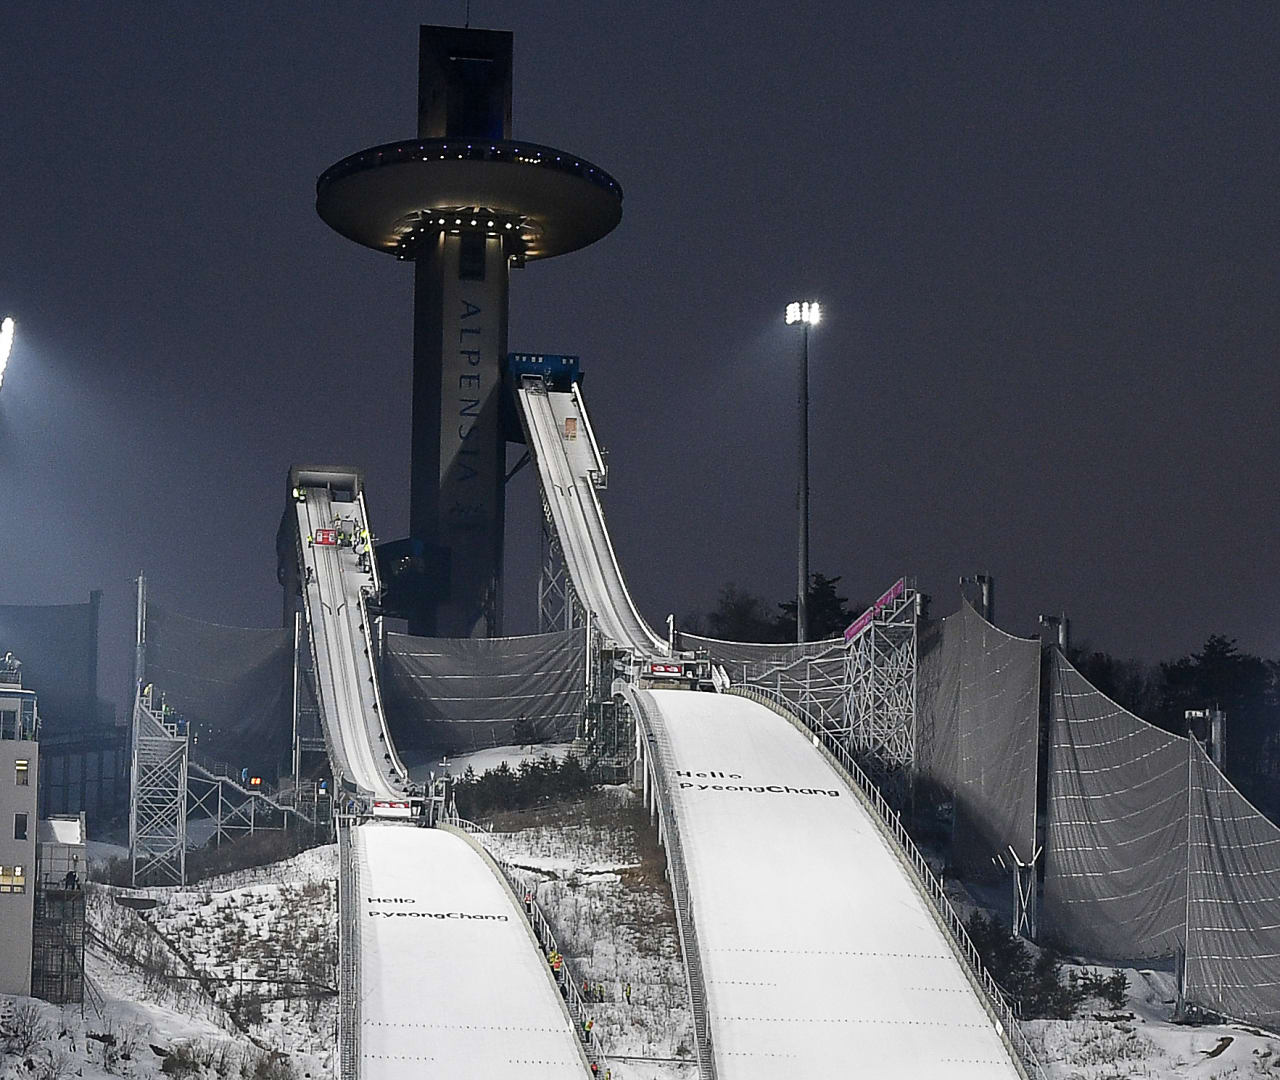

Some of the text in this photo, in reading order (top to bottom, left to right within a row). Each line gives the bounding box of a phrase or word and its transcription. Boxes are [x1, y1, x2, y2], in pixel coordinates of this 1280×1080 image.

[458, 300, 481, 481] ALPENSIA
[676, 770, 742, 779] Hello
[679, 782, 840, 797] PyeongChang
[369, 911, 509, 922] PyeongChang
